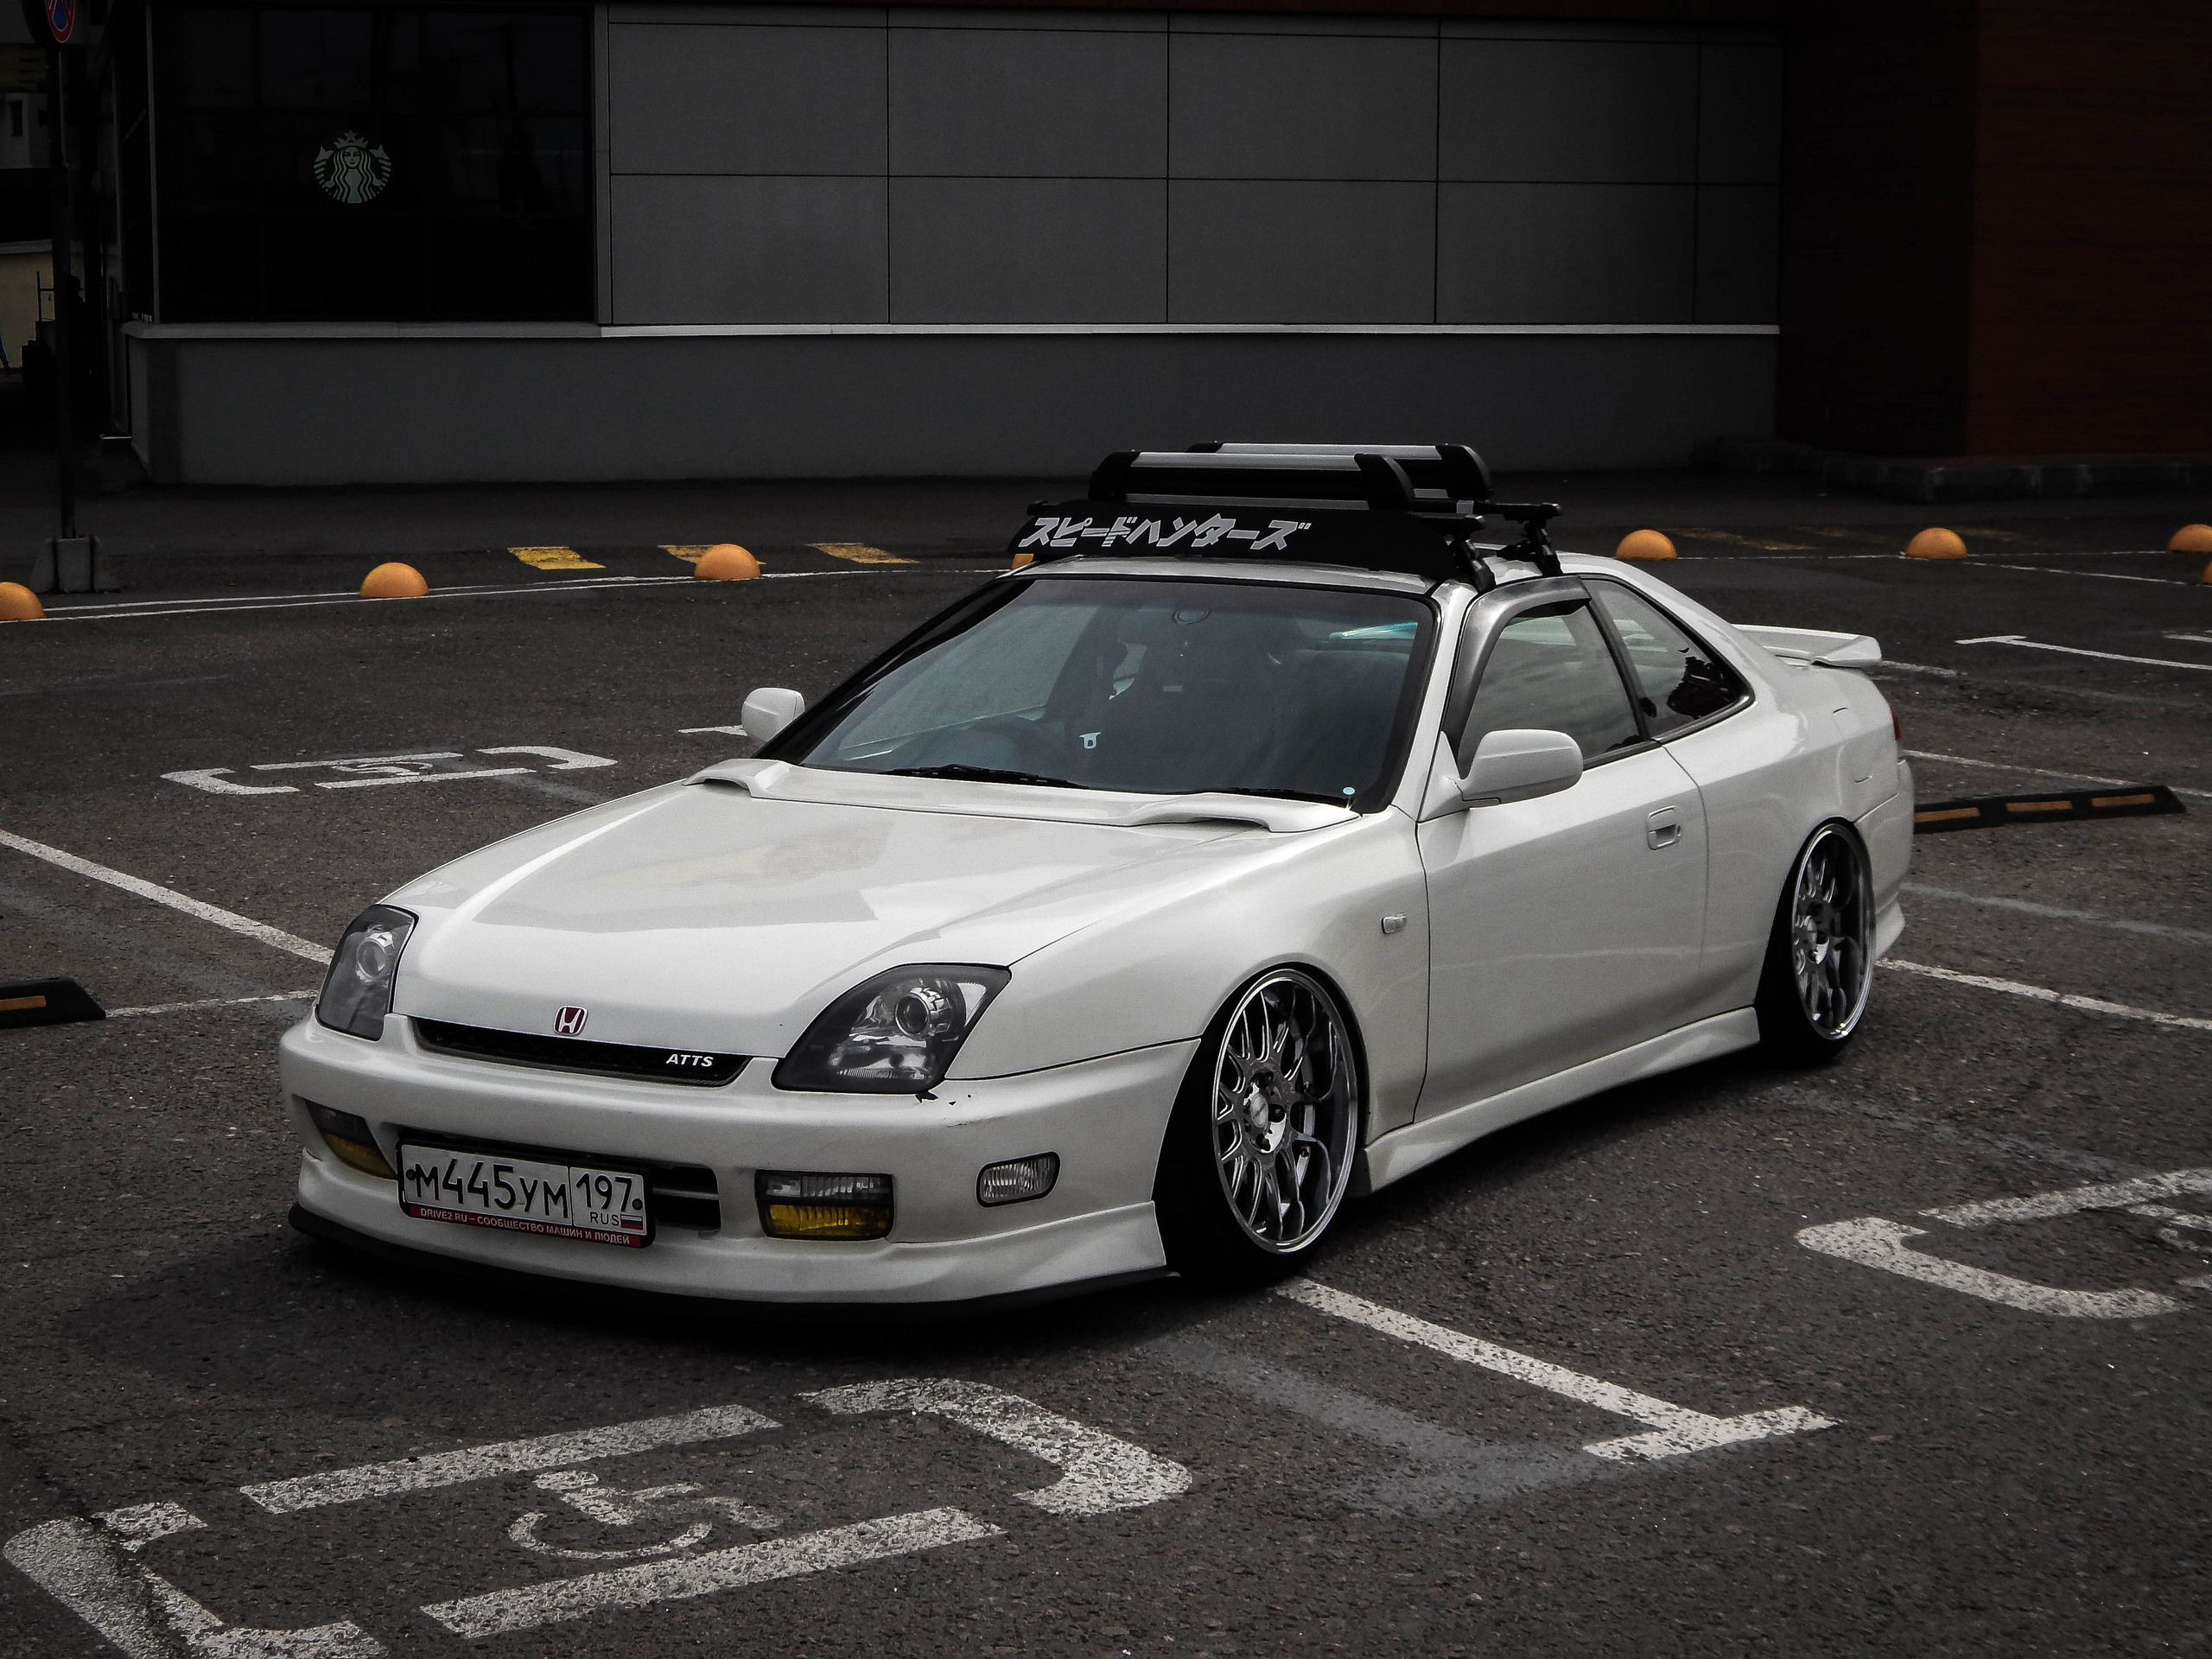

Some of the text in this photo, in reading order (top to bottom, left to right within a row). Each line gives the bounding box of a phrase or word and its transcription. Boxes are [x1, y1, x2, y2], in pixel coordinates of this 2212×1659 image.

[1018, 512, 1312, 551] スピードハンターズ
[665, 1053, 715, 1067] ATTS
[414, 1158, 632, 1219] М445УМ 197
[420, 1208, 467, 1223] DRIVE2.RU
[477, 1216, 544, 1233] СООБЩЕСТВО
[546, 1225, 583, 1239] МАШИН
[585, 1230, 592, 1239] И
[594, 1231, 630, 1244] ЛЮДЕЙ
[589, 1211, 620, 1226] RUS
